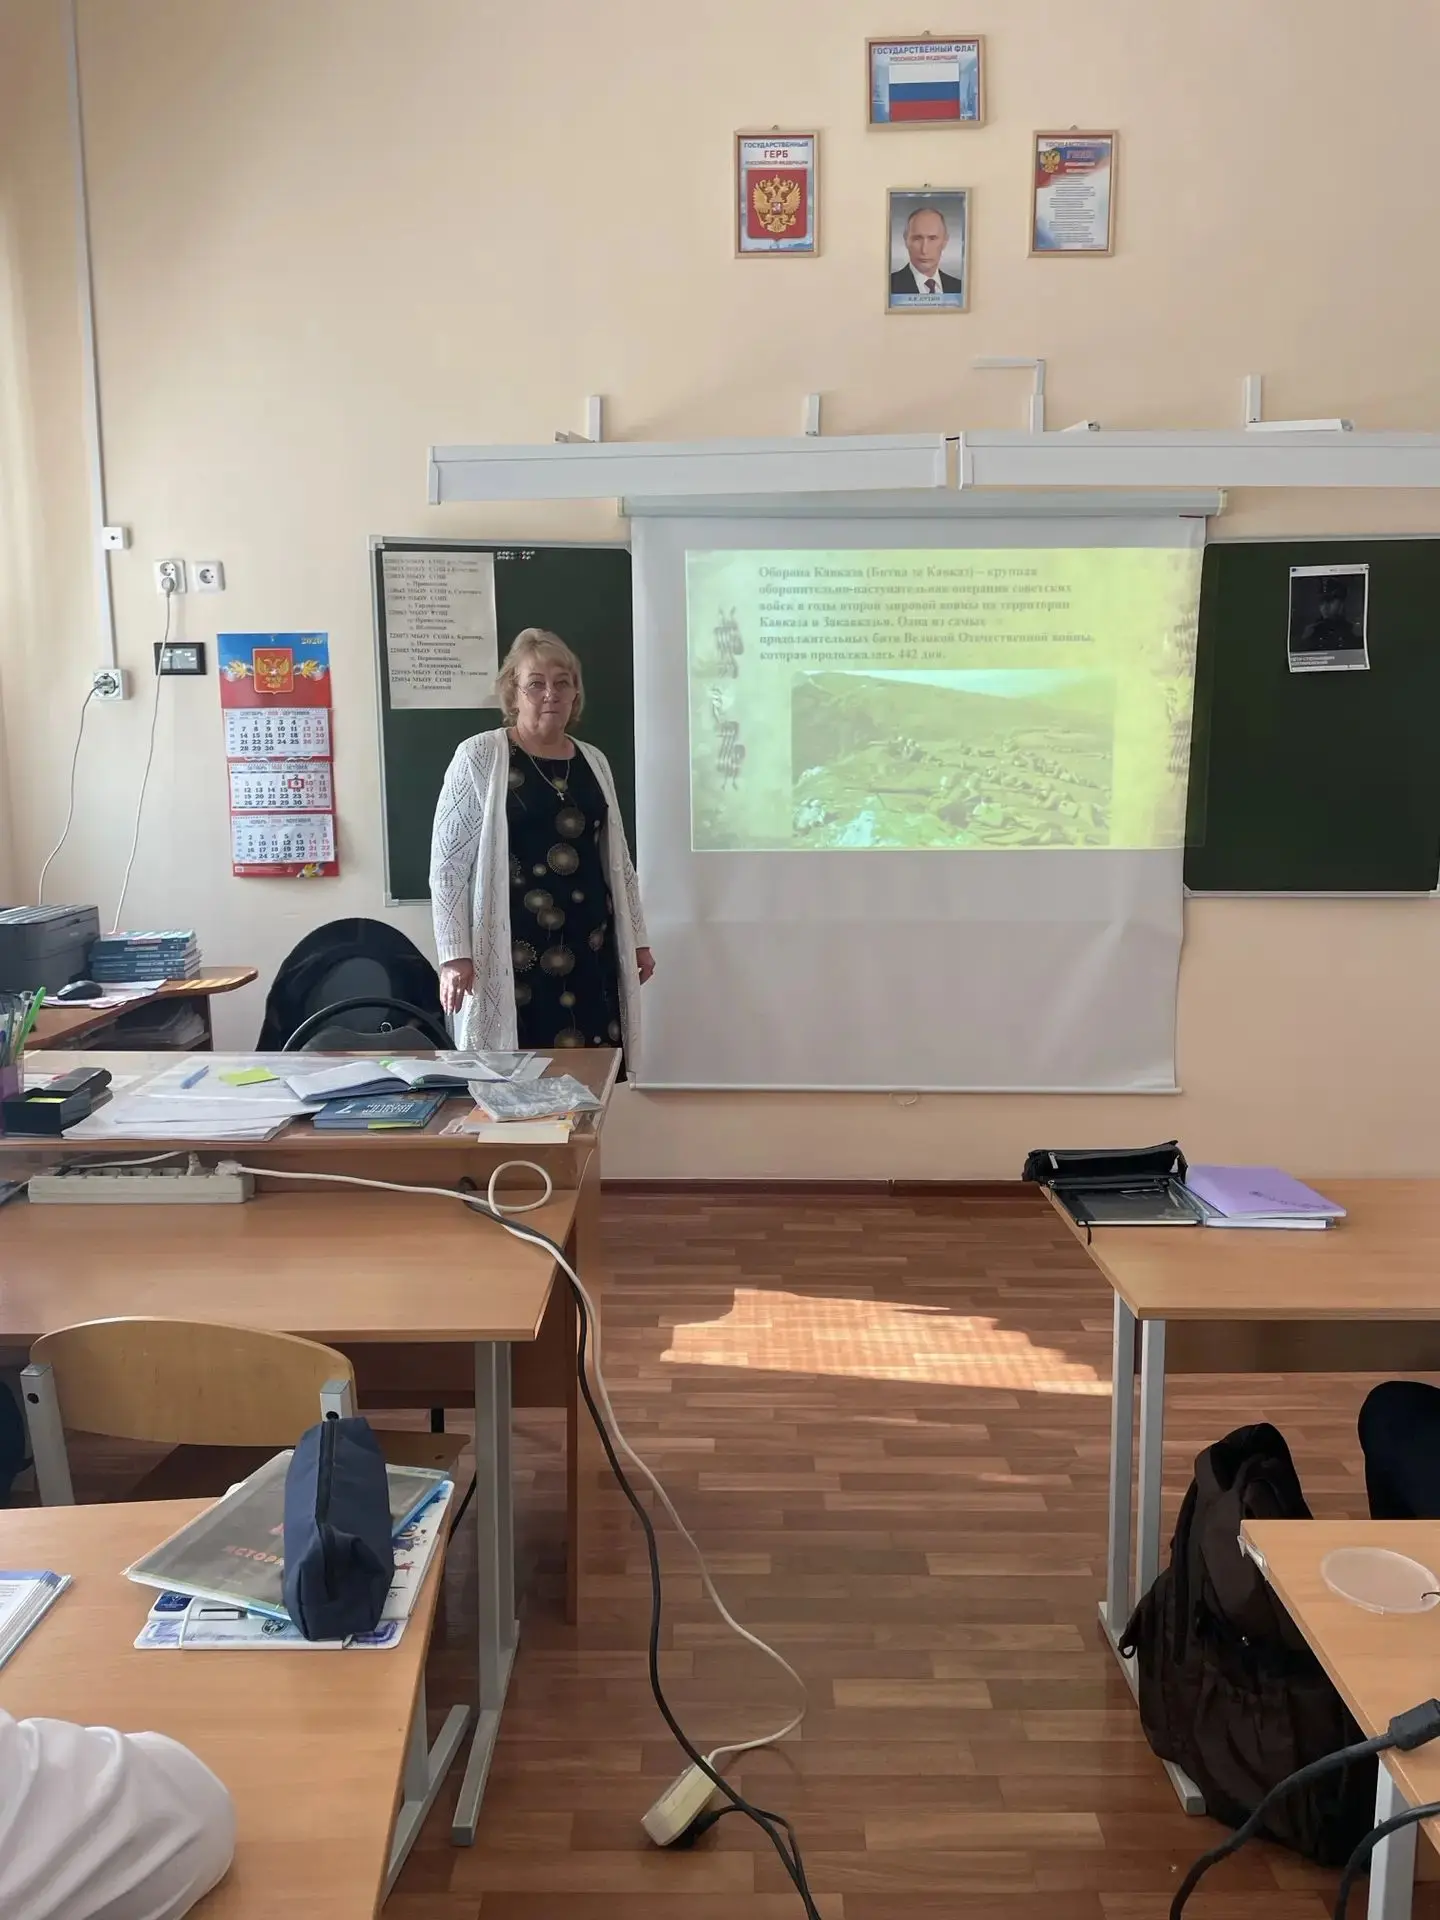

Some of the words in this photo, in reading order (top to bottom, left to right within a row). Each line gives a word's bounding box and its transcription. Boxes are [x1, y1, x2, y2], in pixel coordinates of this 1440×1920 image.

[873, 45, 953, 54] ГОСУДАРСТВЕННЫЙ
[764, 150, 788, 158] ГЕРБ
[759, 566, 810, 580] Оборона
[814, 567, 863, 577] Кавказа
[760, 617, 808, 627] Кавказа
[898, 649, 918, 659] 442
[226, 1545, 284, 1566] ИСТОРИ
